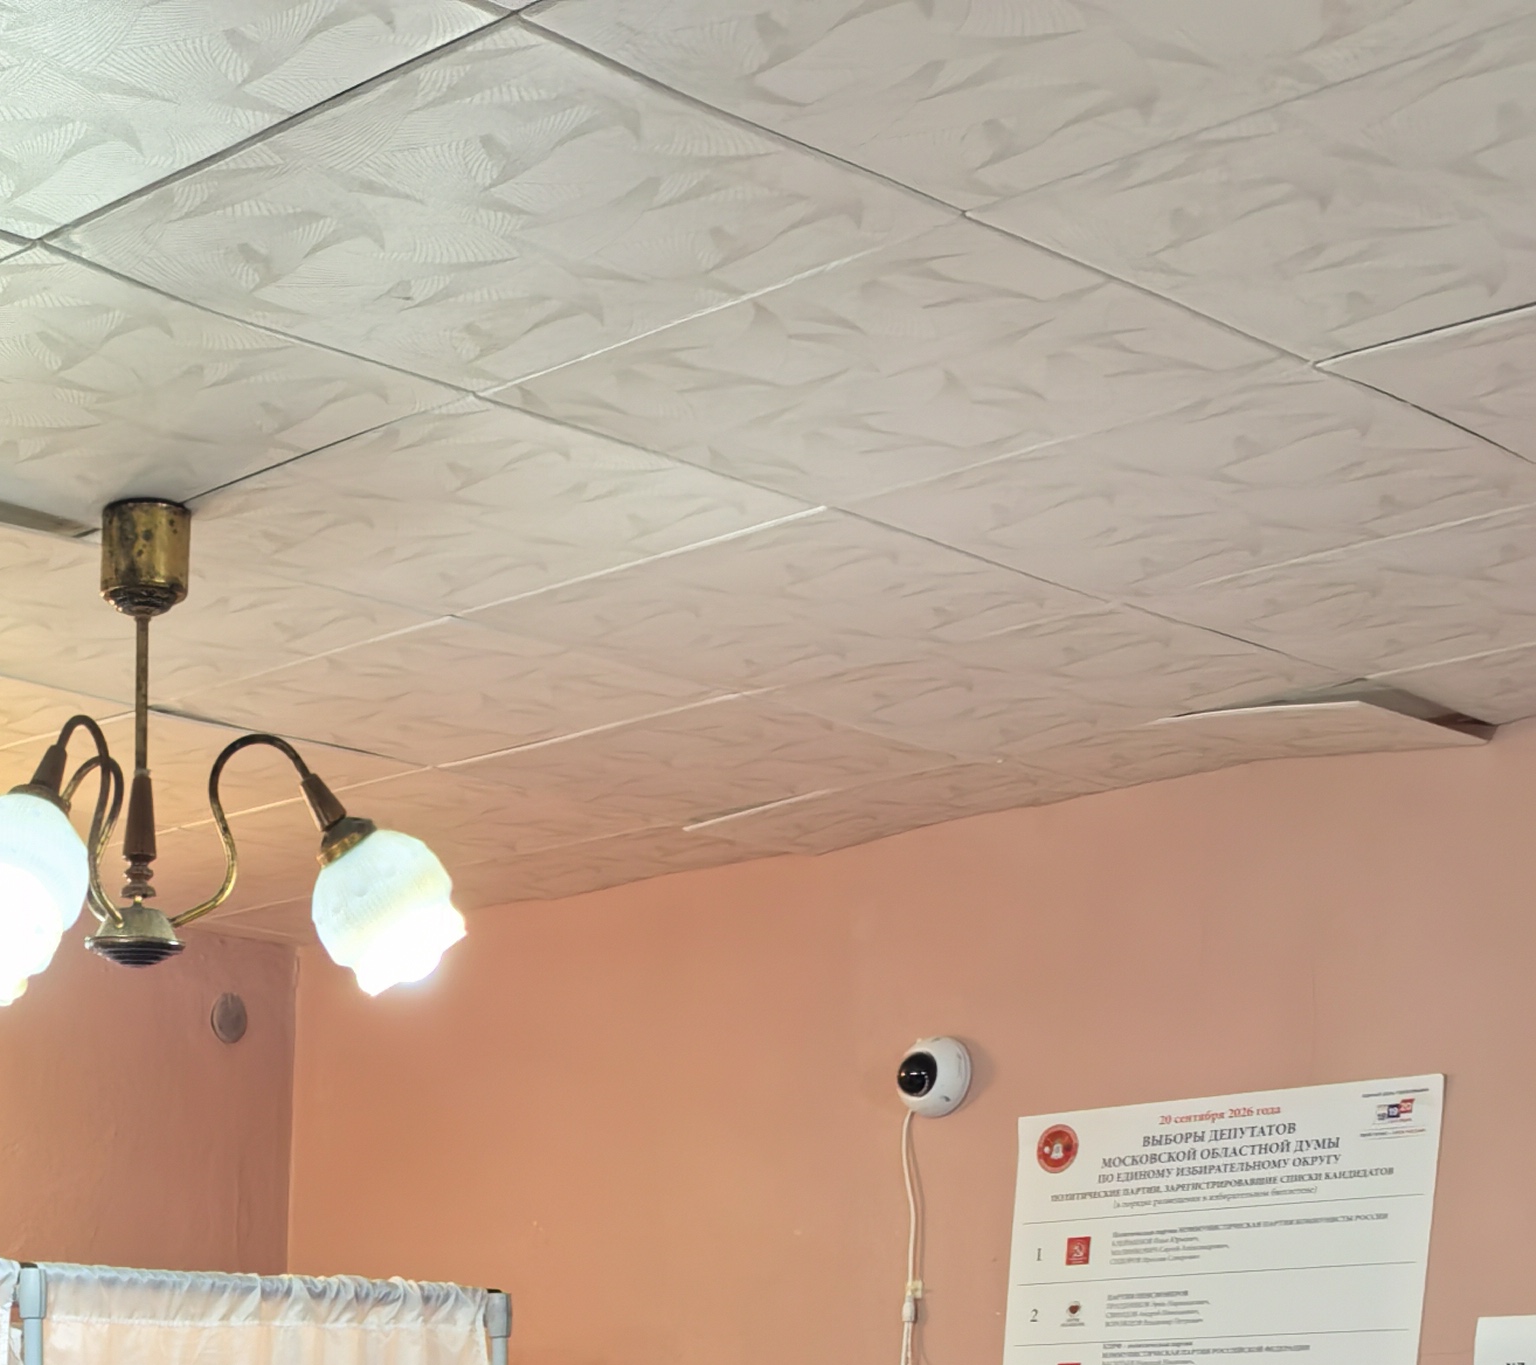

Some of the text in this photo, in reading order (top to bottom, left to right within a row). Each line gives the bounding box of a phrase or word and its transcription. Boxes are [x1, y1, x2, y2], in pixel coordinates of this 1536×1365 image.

[1158, 1115, 1171, 1125] 20
[1174, 1110, 1225, 1123] сентября
[1228, 1107, 1254, 1118] 2026
[1143, 1122, 1296, 1147] ВЫБОРЫ ДЕПУТАТОВ
[1101, 1137, 1340, 1169] МОСКОВСКОЙ ОБЛАСТНОЙ ДУМЫ
[1098, 1154, 1341, 1184] ПО ЕДИНОМУ ИЗБИРАТЕЛЬНОМУ ОКРУГУ
[1036, 1248, 1042, 1261] 1
[1029, 1309, 1039, 1323] 2
